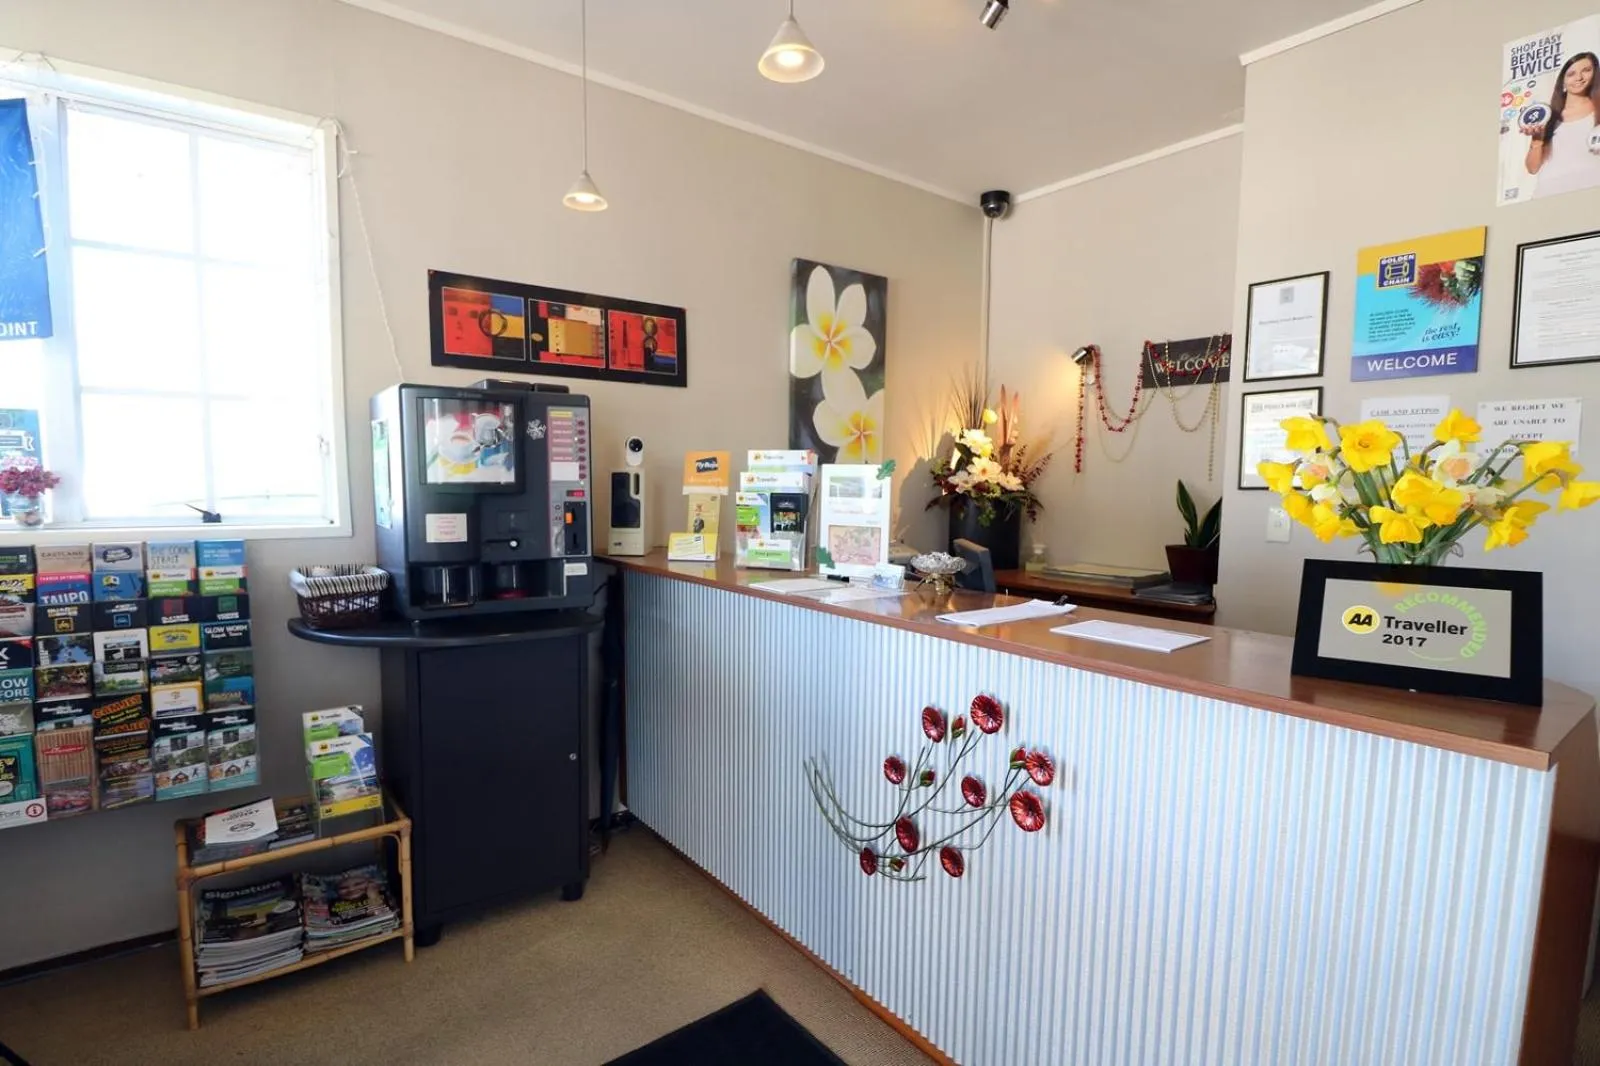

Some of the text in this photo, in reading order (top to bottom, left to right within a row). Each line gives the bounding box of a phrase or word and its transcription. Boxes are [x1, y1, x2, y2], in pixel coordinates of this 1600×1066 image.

[1510, 33, 1562, 56] SHOP EASY
[1510, 42, 1562, 67] BENEFIT
[1510, 53, 1561, 80] TWICE
[1381, 254, 1415, 264] GOLDEN
[1383, 278, 1410, 286] CHAIN
[1367, 353, 1458, 372] WELCOME
[204, 626, 225, 634] GLOW
[1348, 613, 1469, 636] AA Traveller
[1395, 592, 1488, 659] RECOMMENDED
[1382, 633, 1428, 648] 2017
[205, 880, 283, 899] Signature
